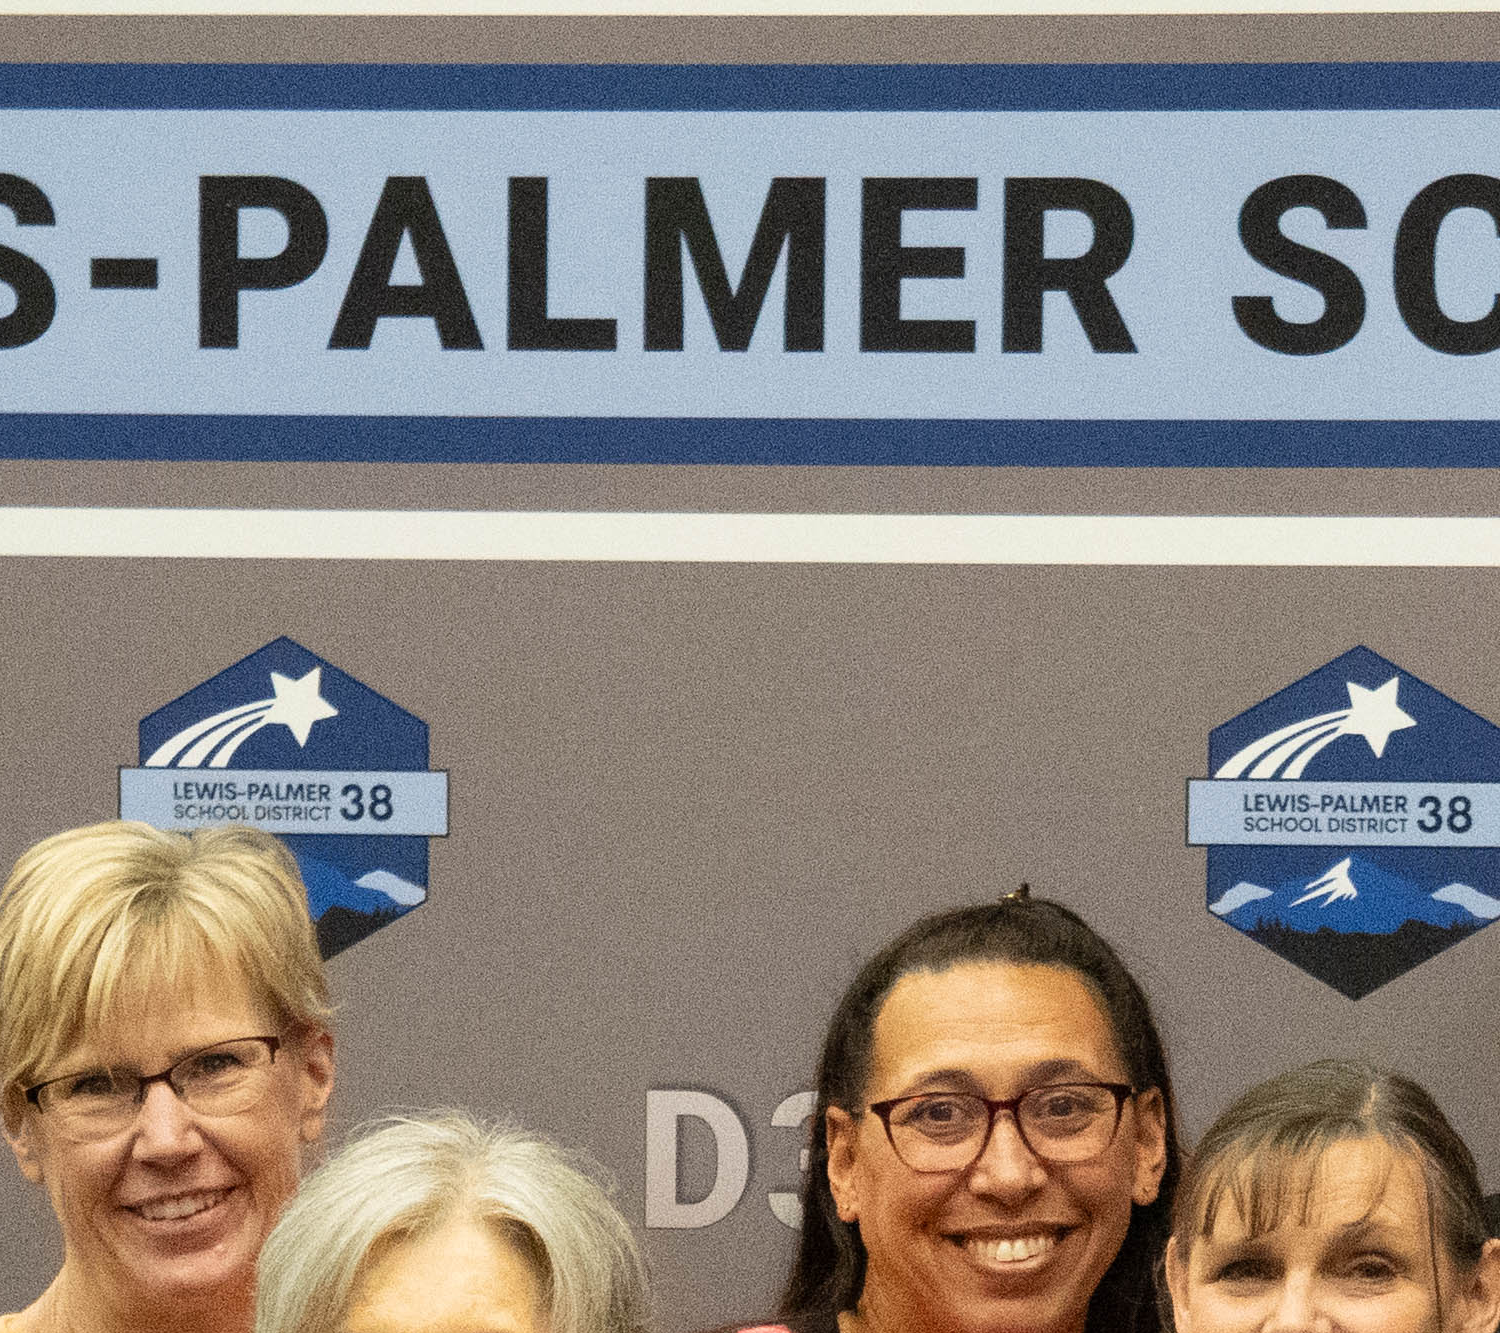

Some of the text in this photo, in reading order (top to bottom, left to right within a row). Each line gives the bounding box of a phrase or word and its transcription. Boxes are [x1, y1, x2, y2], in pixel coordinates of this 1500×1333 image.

[173, 781, 331, 801] LEWIS-PALMER
[173, 804, 332, 822] SCHOOL DISTRICT
[340, 784, 394, 822] 38
[1243, 794, 1408, 814] LEWIS-PALMER
[1417, 795, 1473, 834] 38
[1243, 816, 1409, 834] SCHOOL DISTRICT
